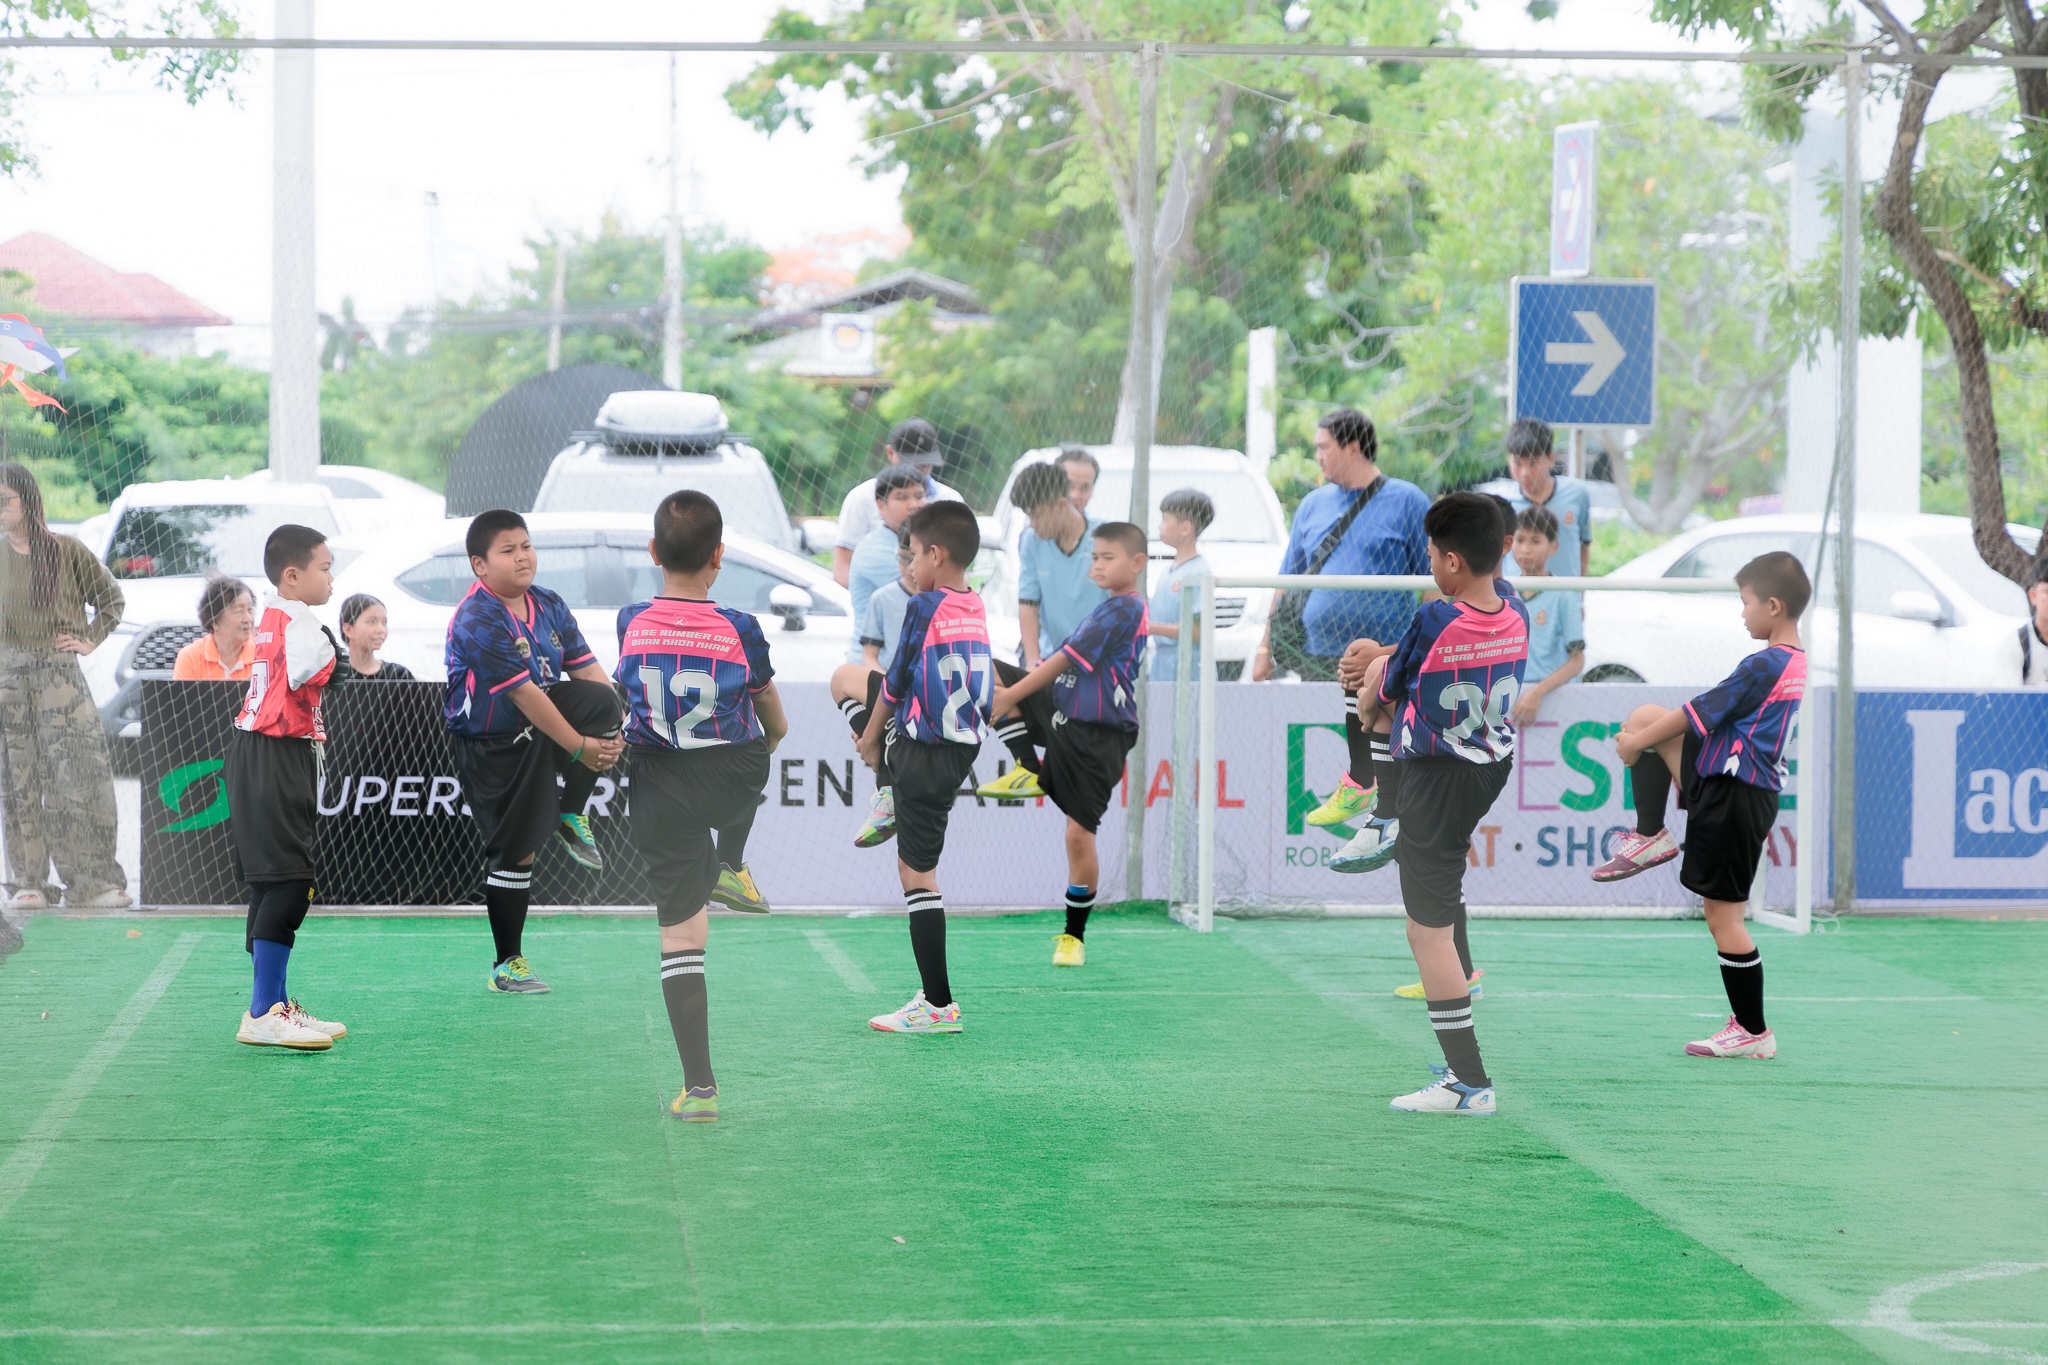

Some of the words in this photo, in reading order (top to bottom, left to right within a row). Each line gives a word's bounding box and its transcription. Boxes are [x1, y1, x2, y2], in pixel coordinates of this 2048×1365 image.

[626, 630, 639, 638] TO
[641, 629, 657, 637] BE
[660, 630, 711, 640] NUMBER
[713, 635, 739, 646] ONE
[933, 620, 946, 629] TO
[1436, 646, 1452, 655] TO
[1455, 643, 1472, 653] BE
[1474, 638, 1513, 650] NUMBER
[638, 665, 731, 750] 12
[937, 653, 990, 745] 27
[1903, 710, 2048, 889] Lac
